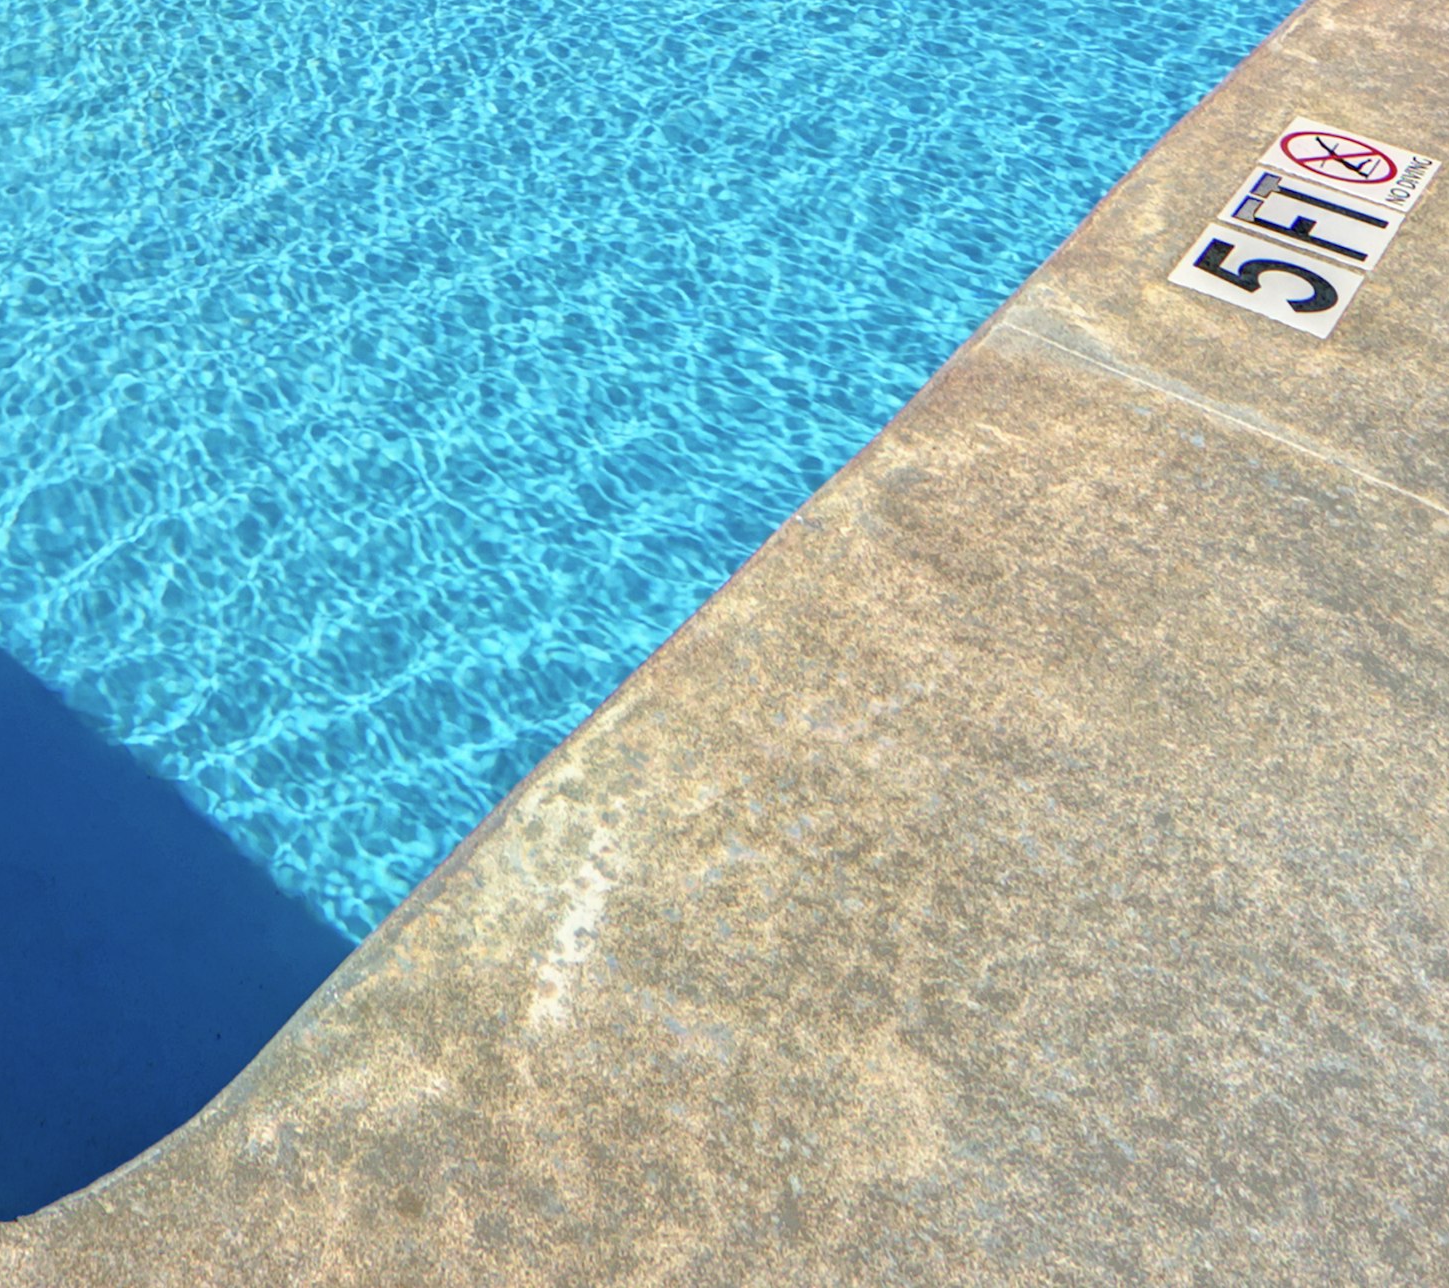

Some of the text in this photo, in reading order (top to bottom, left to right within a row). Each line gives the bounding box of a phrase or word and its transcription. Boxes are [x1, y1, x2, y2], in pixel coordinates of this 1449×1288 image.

[1385, 156, 1433, 206] NO DIVING
[1193, 172, 1389, 313] 5 FT
